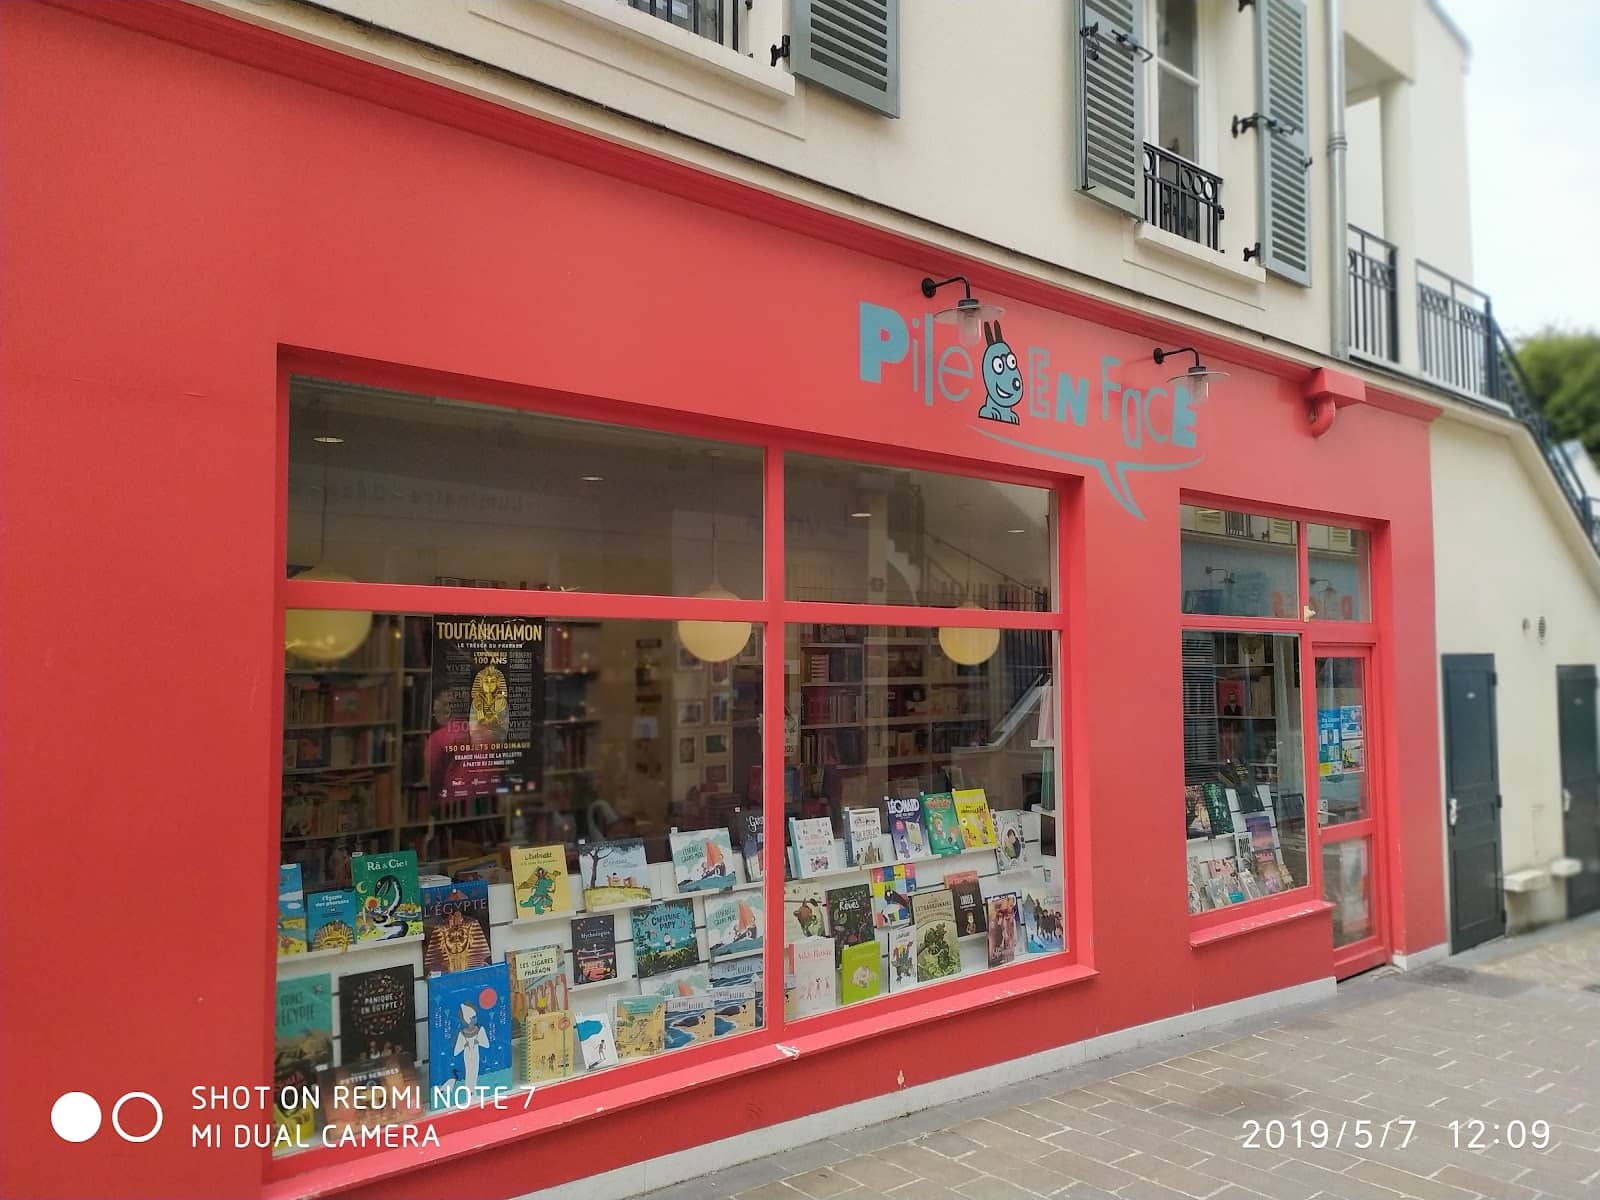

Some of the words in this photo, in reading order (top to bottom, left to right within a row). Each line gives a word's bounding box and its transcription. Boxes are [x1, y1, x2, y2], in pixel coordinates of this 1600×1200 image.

[859, 301, 974, 407] Pile
[1028, 345, 1090, 426] EN
[490, 656, 508, 665] ANS
